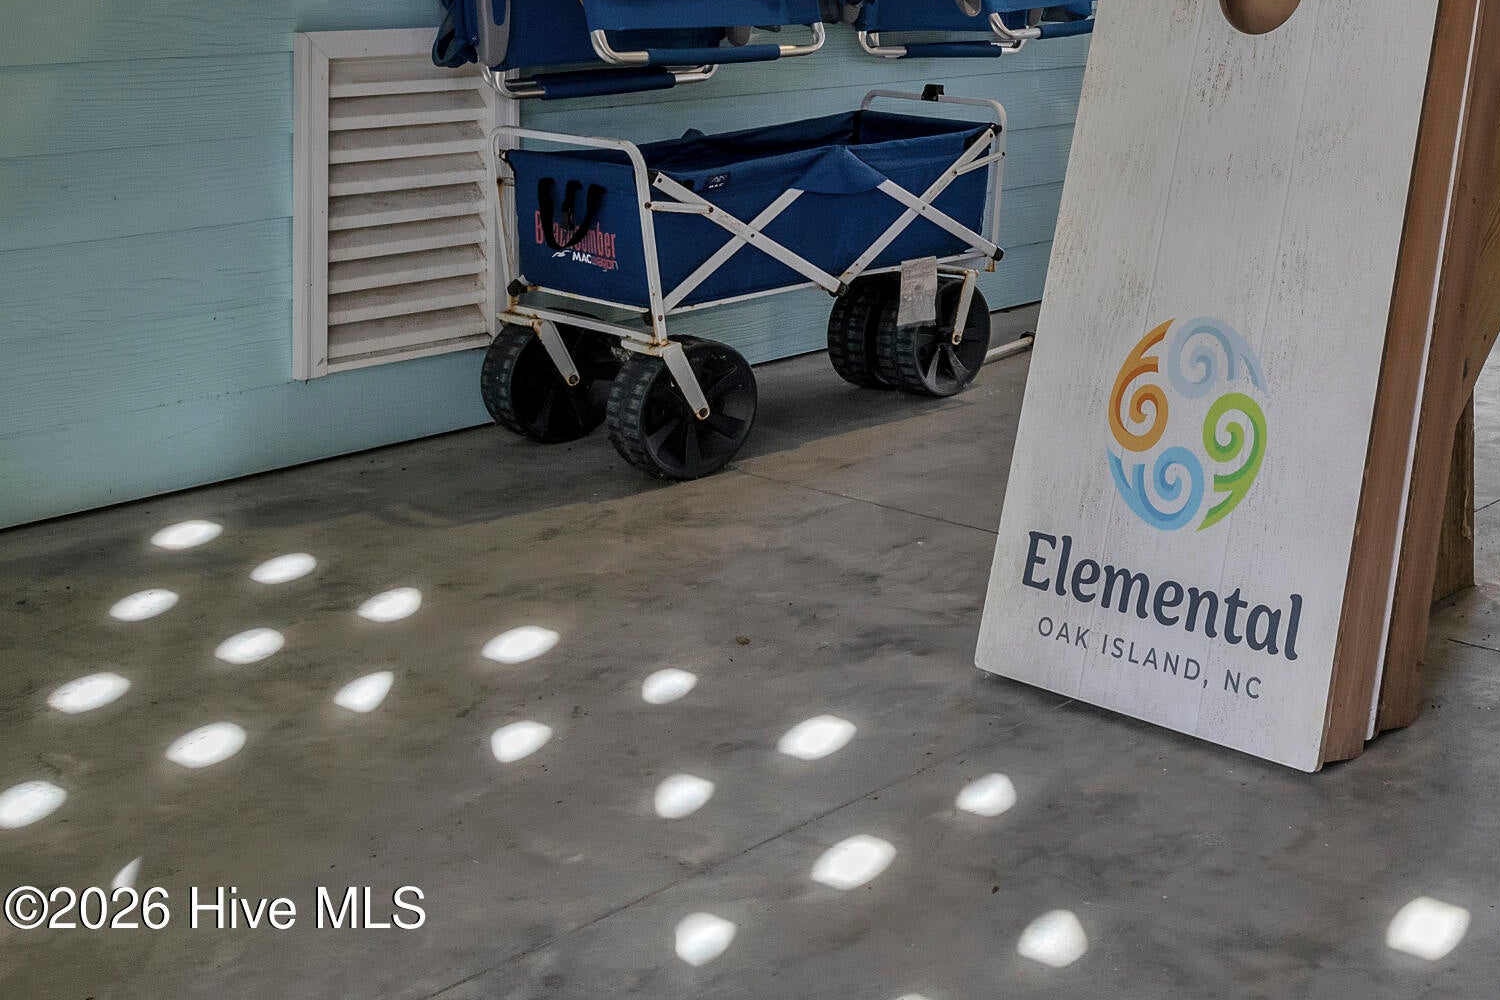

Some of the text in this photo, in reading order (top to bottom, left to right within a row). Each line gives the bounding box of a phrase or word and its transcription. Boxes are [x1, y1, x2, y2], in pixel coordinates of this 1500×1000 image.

[1022, 530, 1303, 661] Elemental
[1038, 616, 1262, 699] OAK ISLAND, NC
